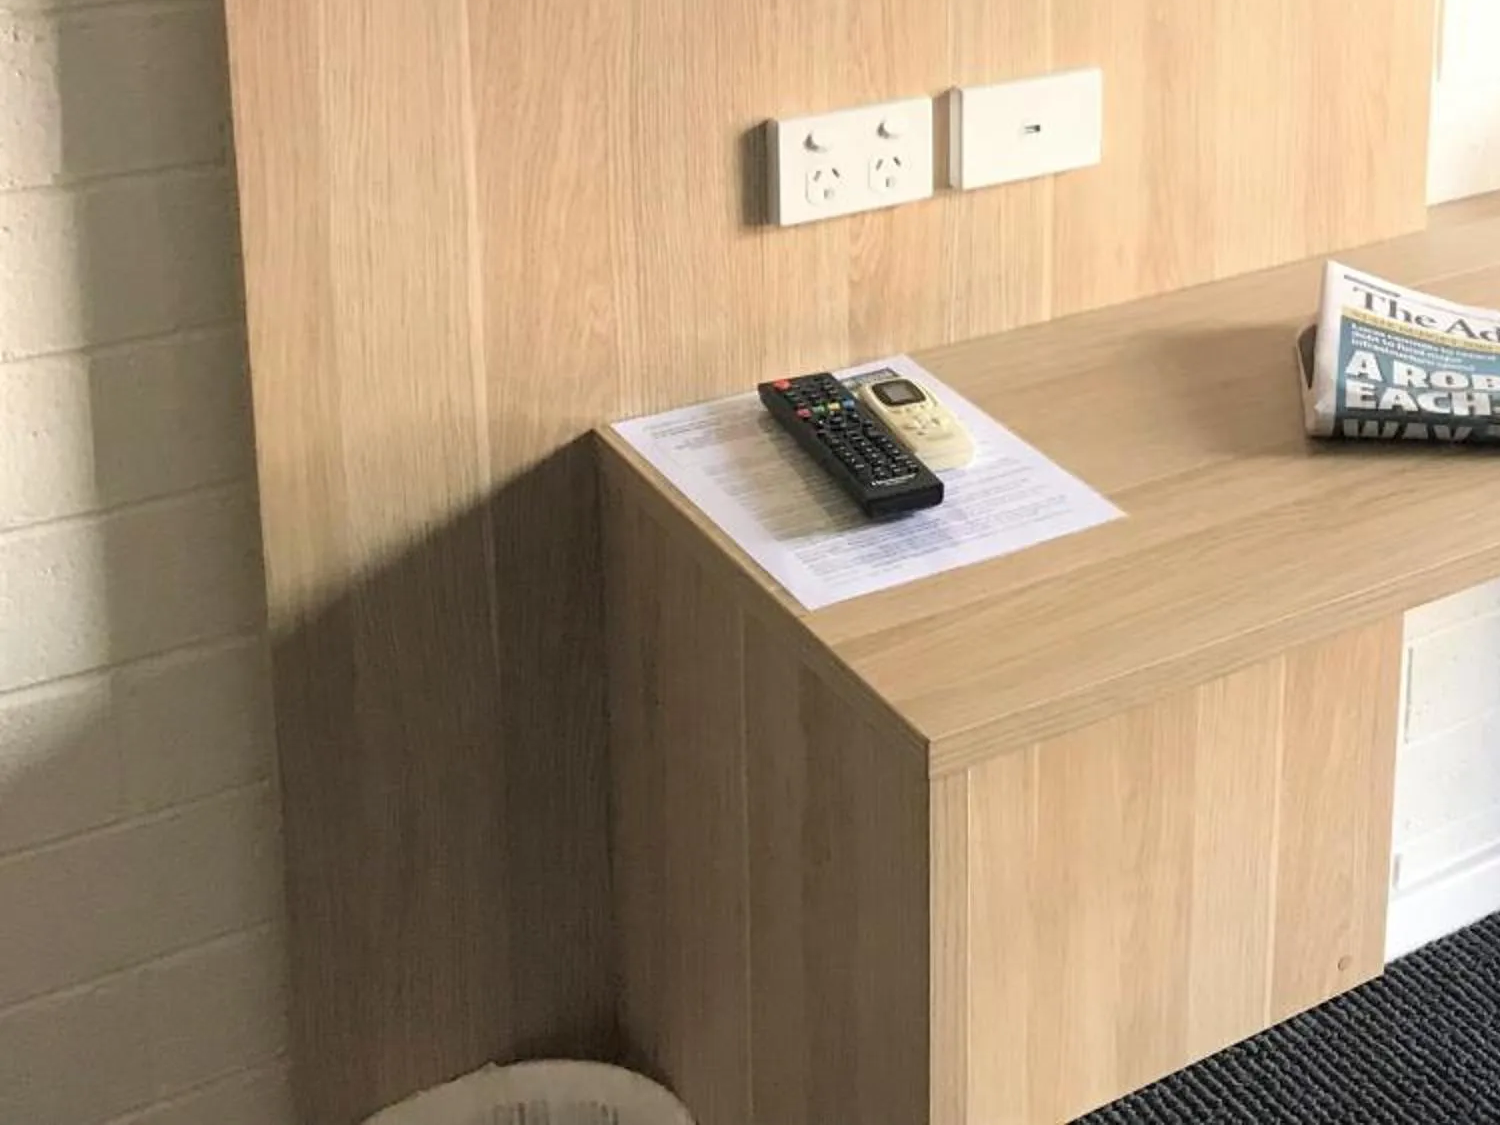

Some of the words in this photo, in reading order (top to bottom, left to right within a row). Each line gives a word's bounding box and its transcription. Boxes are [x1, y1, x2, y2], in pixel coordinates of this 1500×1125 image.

[1353, 286, 1438, 328] The
[1345, 350, 1383, 382] A
[1344, 378, 1492, 417] EACH
